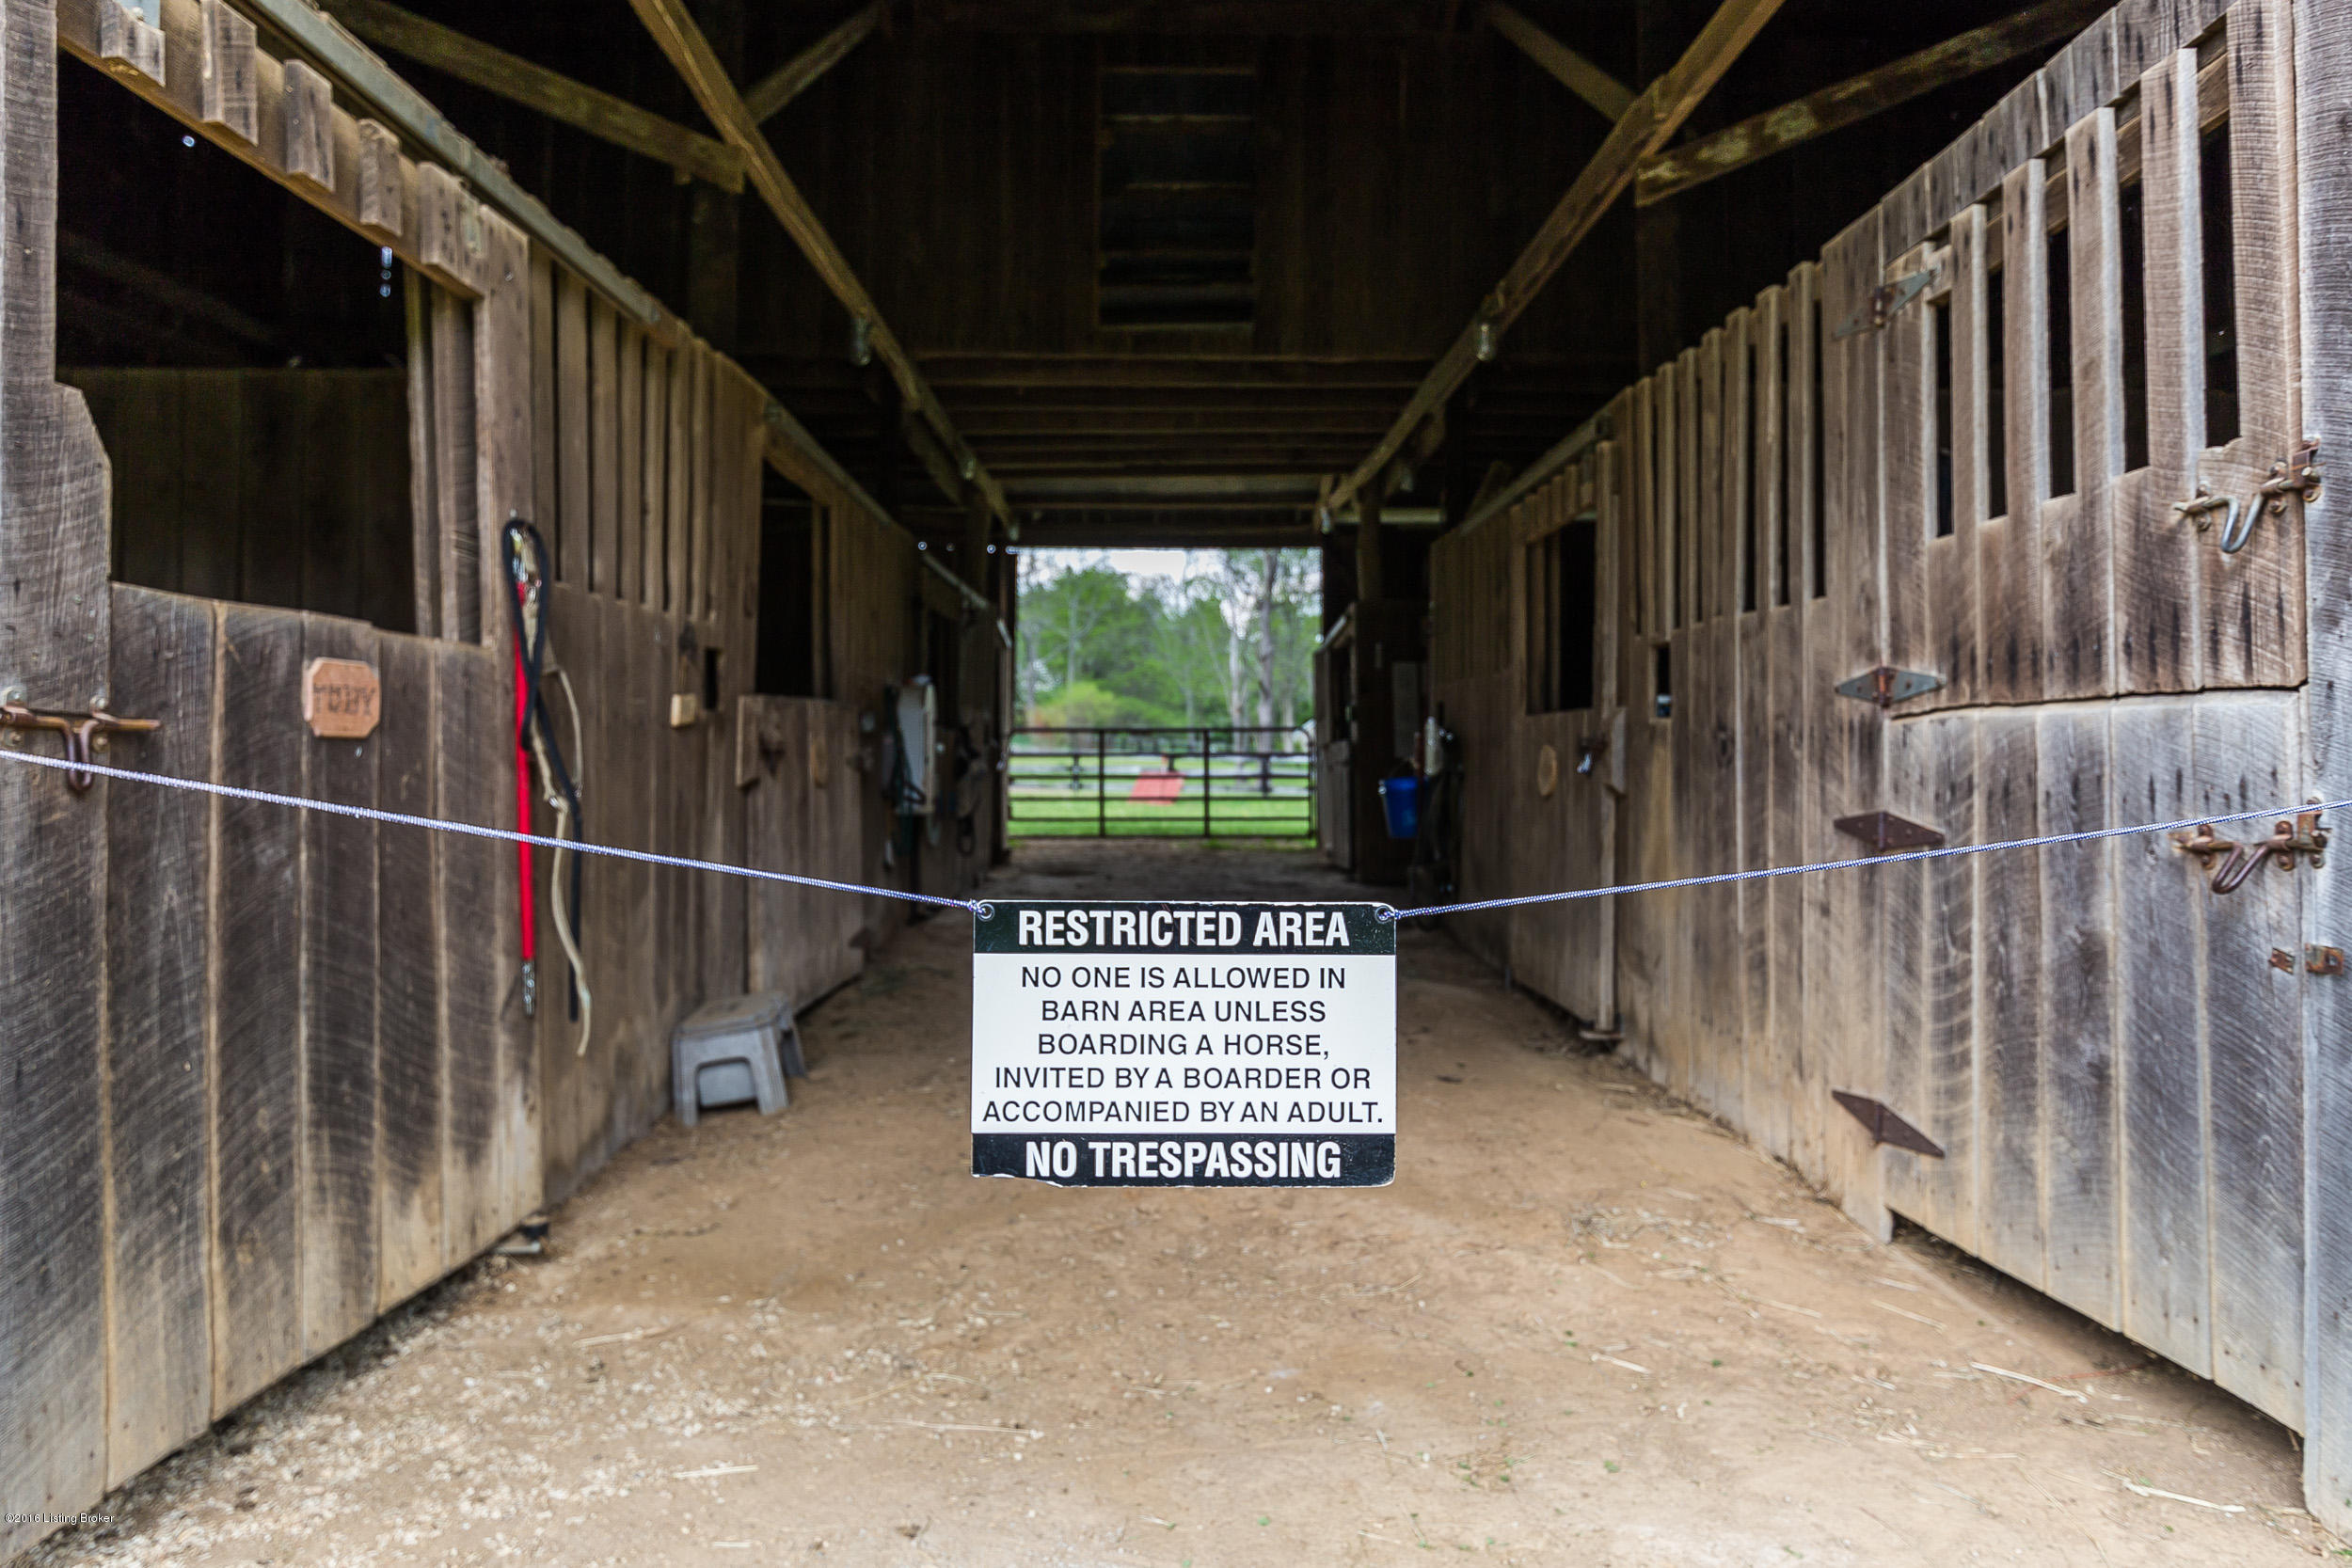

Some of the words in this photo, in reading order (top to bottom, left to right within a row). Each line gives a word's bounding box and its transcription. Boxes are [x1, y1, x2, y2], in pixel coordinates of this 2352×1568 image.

[1018, 910, 1241, 946] RESTRICTED
[1253, 911, 1350, 947] AREA
[1021, 967, 1062, 989] NO
[1071, 967, 1130, 989] ONE
[1140, 967, 1165, 989] IS
[1173, 967, 1311, 990] ALLOWED
[1318, 967, 1345, 990] IN
[1041, 1000, 1120, 1022] BARN
[1128, 1000, 1206, 1022] AREA
[1215, 1000, 1326, 1022] UNLESS
[1038, 1034, 1186, 1056] BOARDING
[1195, 1034, 1214, 1056] A
[1223, 1034, 1329, 1060] HORSE,
[994, 1067, 1104, 1089] INVITED
[1115, 1067, 1150, 1089] BY
[1154, 1067, 1173, 1089] A
[1184, 1067, 1320, 1089] BOARDER
[1330, 1067, 1371, 1089] OR
[982, 1101, 1189, 1122] ACCOMPANIED
[1200, 1101, 1233, 1123] BY
[1240, 1101, 1279, 1123] AN
[1287, 1101, 1383, 1123] ADULT.
[1025, 1141, 1077, 1178] NO
[1088, 1141, 1341, 1179] TRESPASSING
